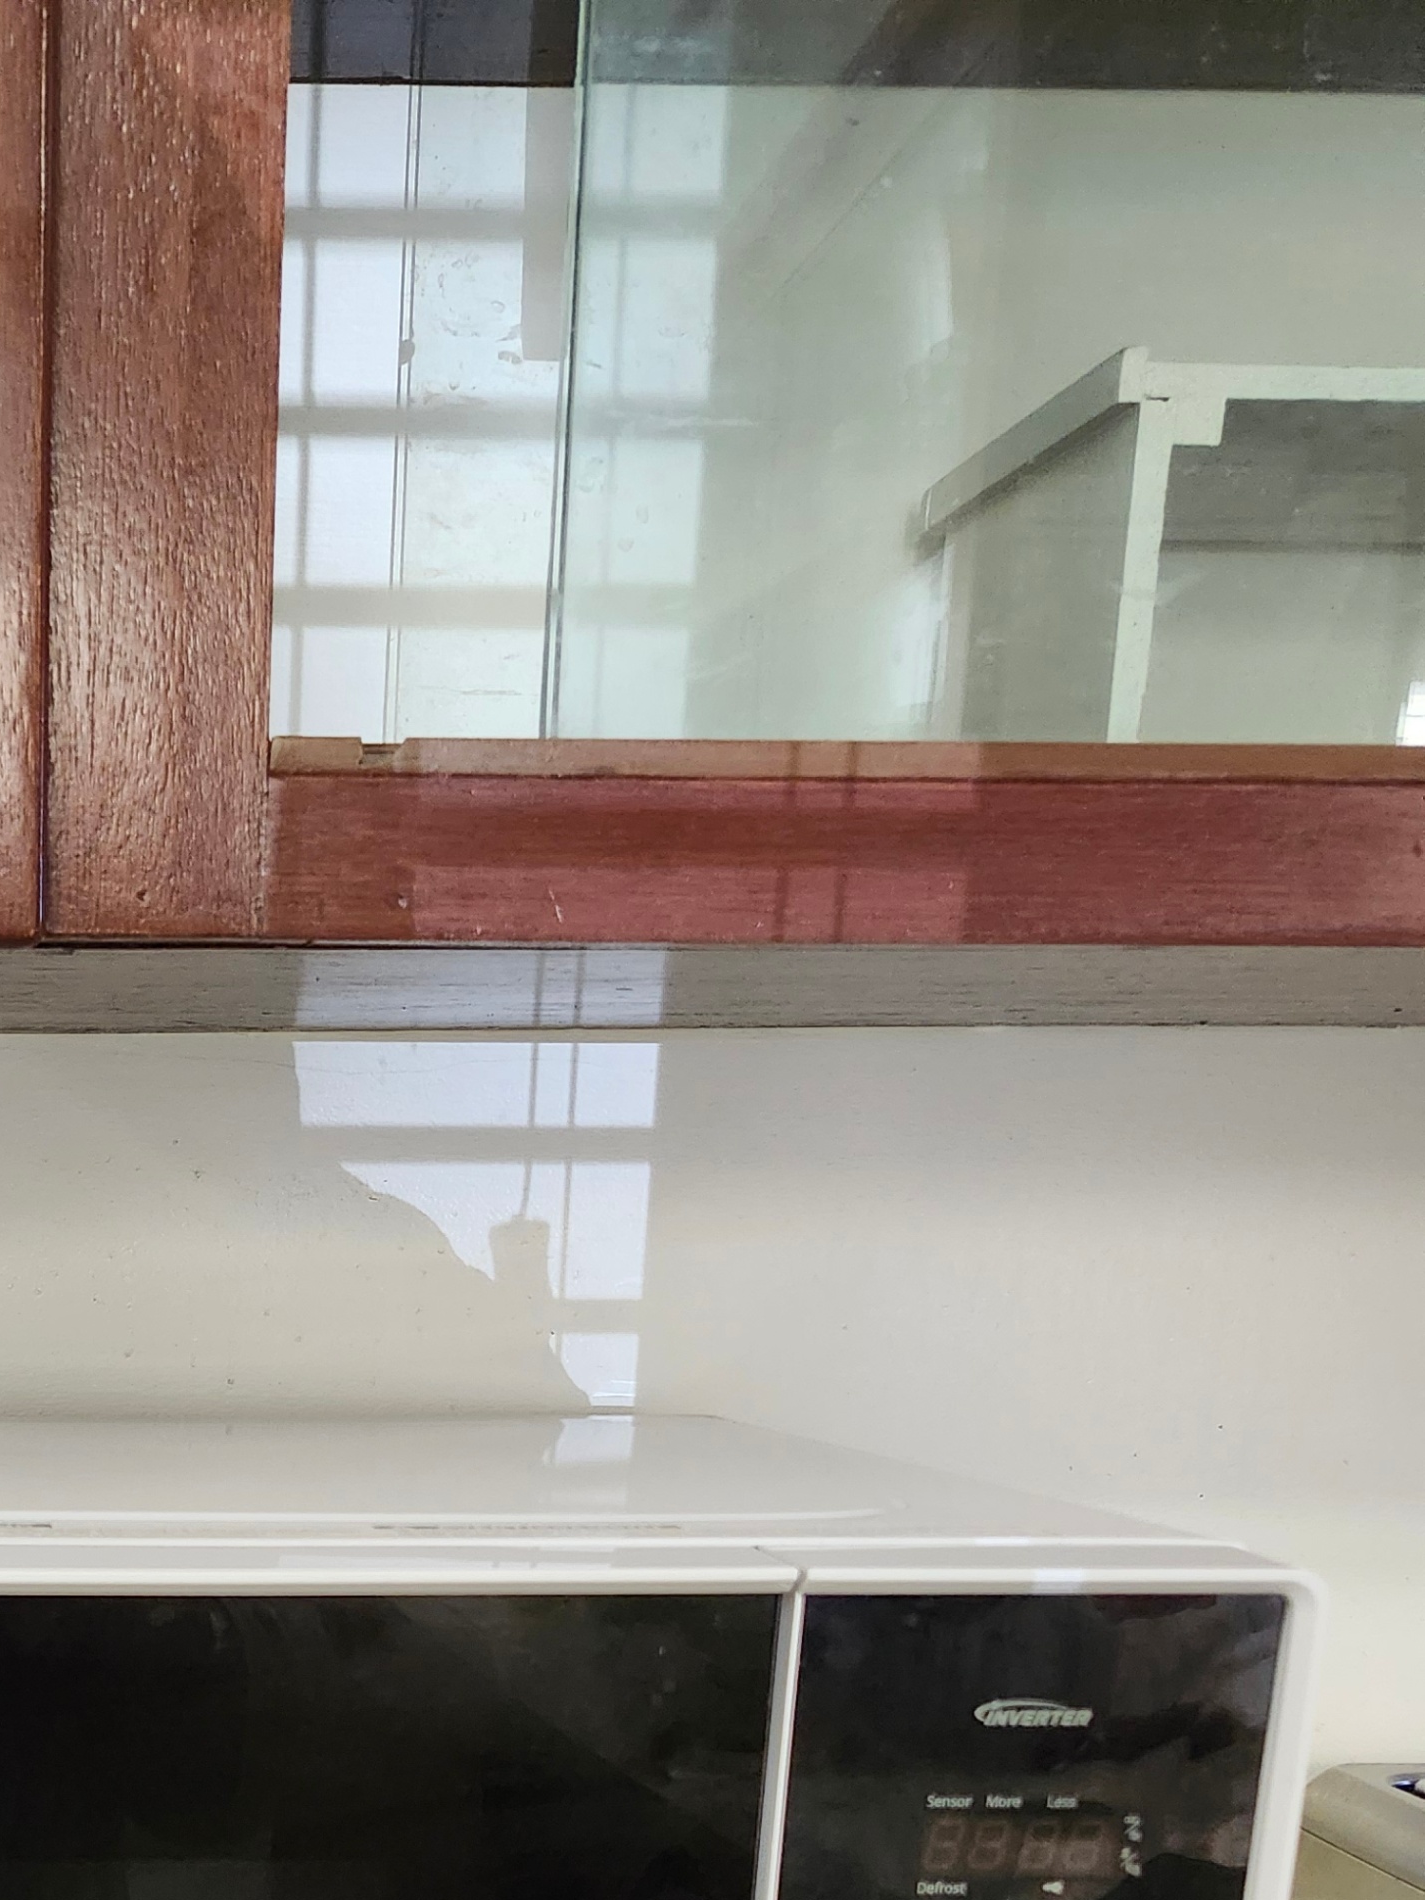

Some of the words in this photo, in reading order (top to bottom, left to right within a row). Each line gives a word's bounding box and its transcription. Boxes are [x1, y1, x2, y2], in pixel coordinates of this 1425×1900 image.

[983, 1708, 1093, 1727] INVERTER
[926, 1793, 973, 1809] Sensor
[986, 1793, 1023, 1809] More
[1047, 1793, 1078, 1809] Less
[917, 1881, 968, 1897] Defrost
